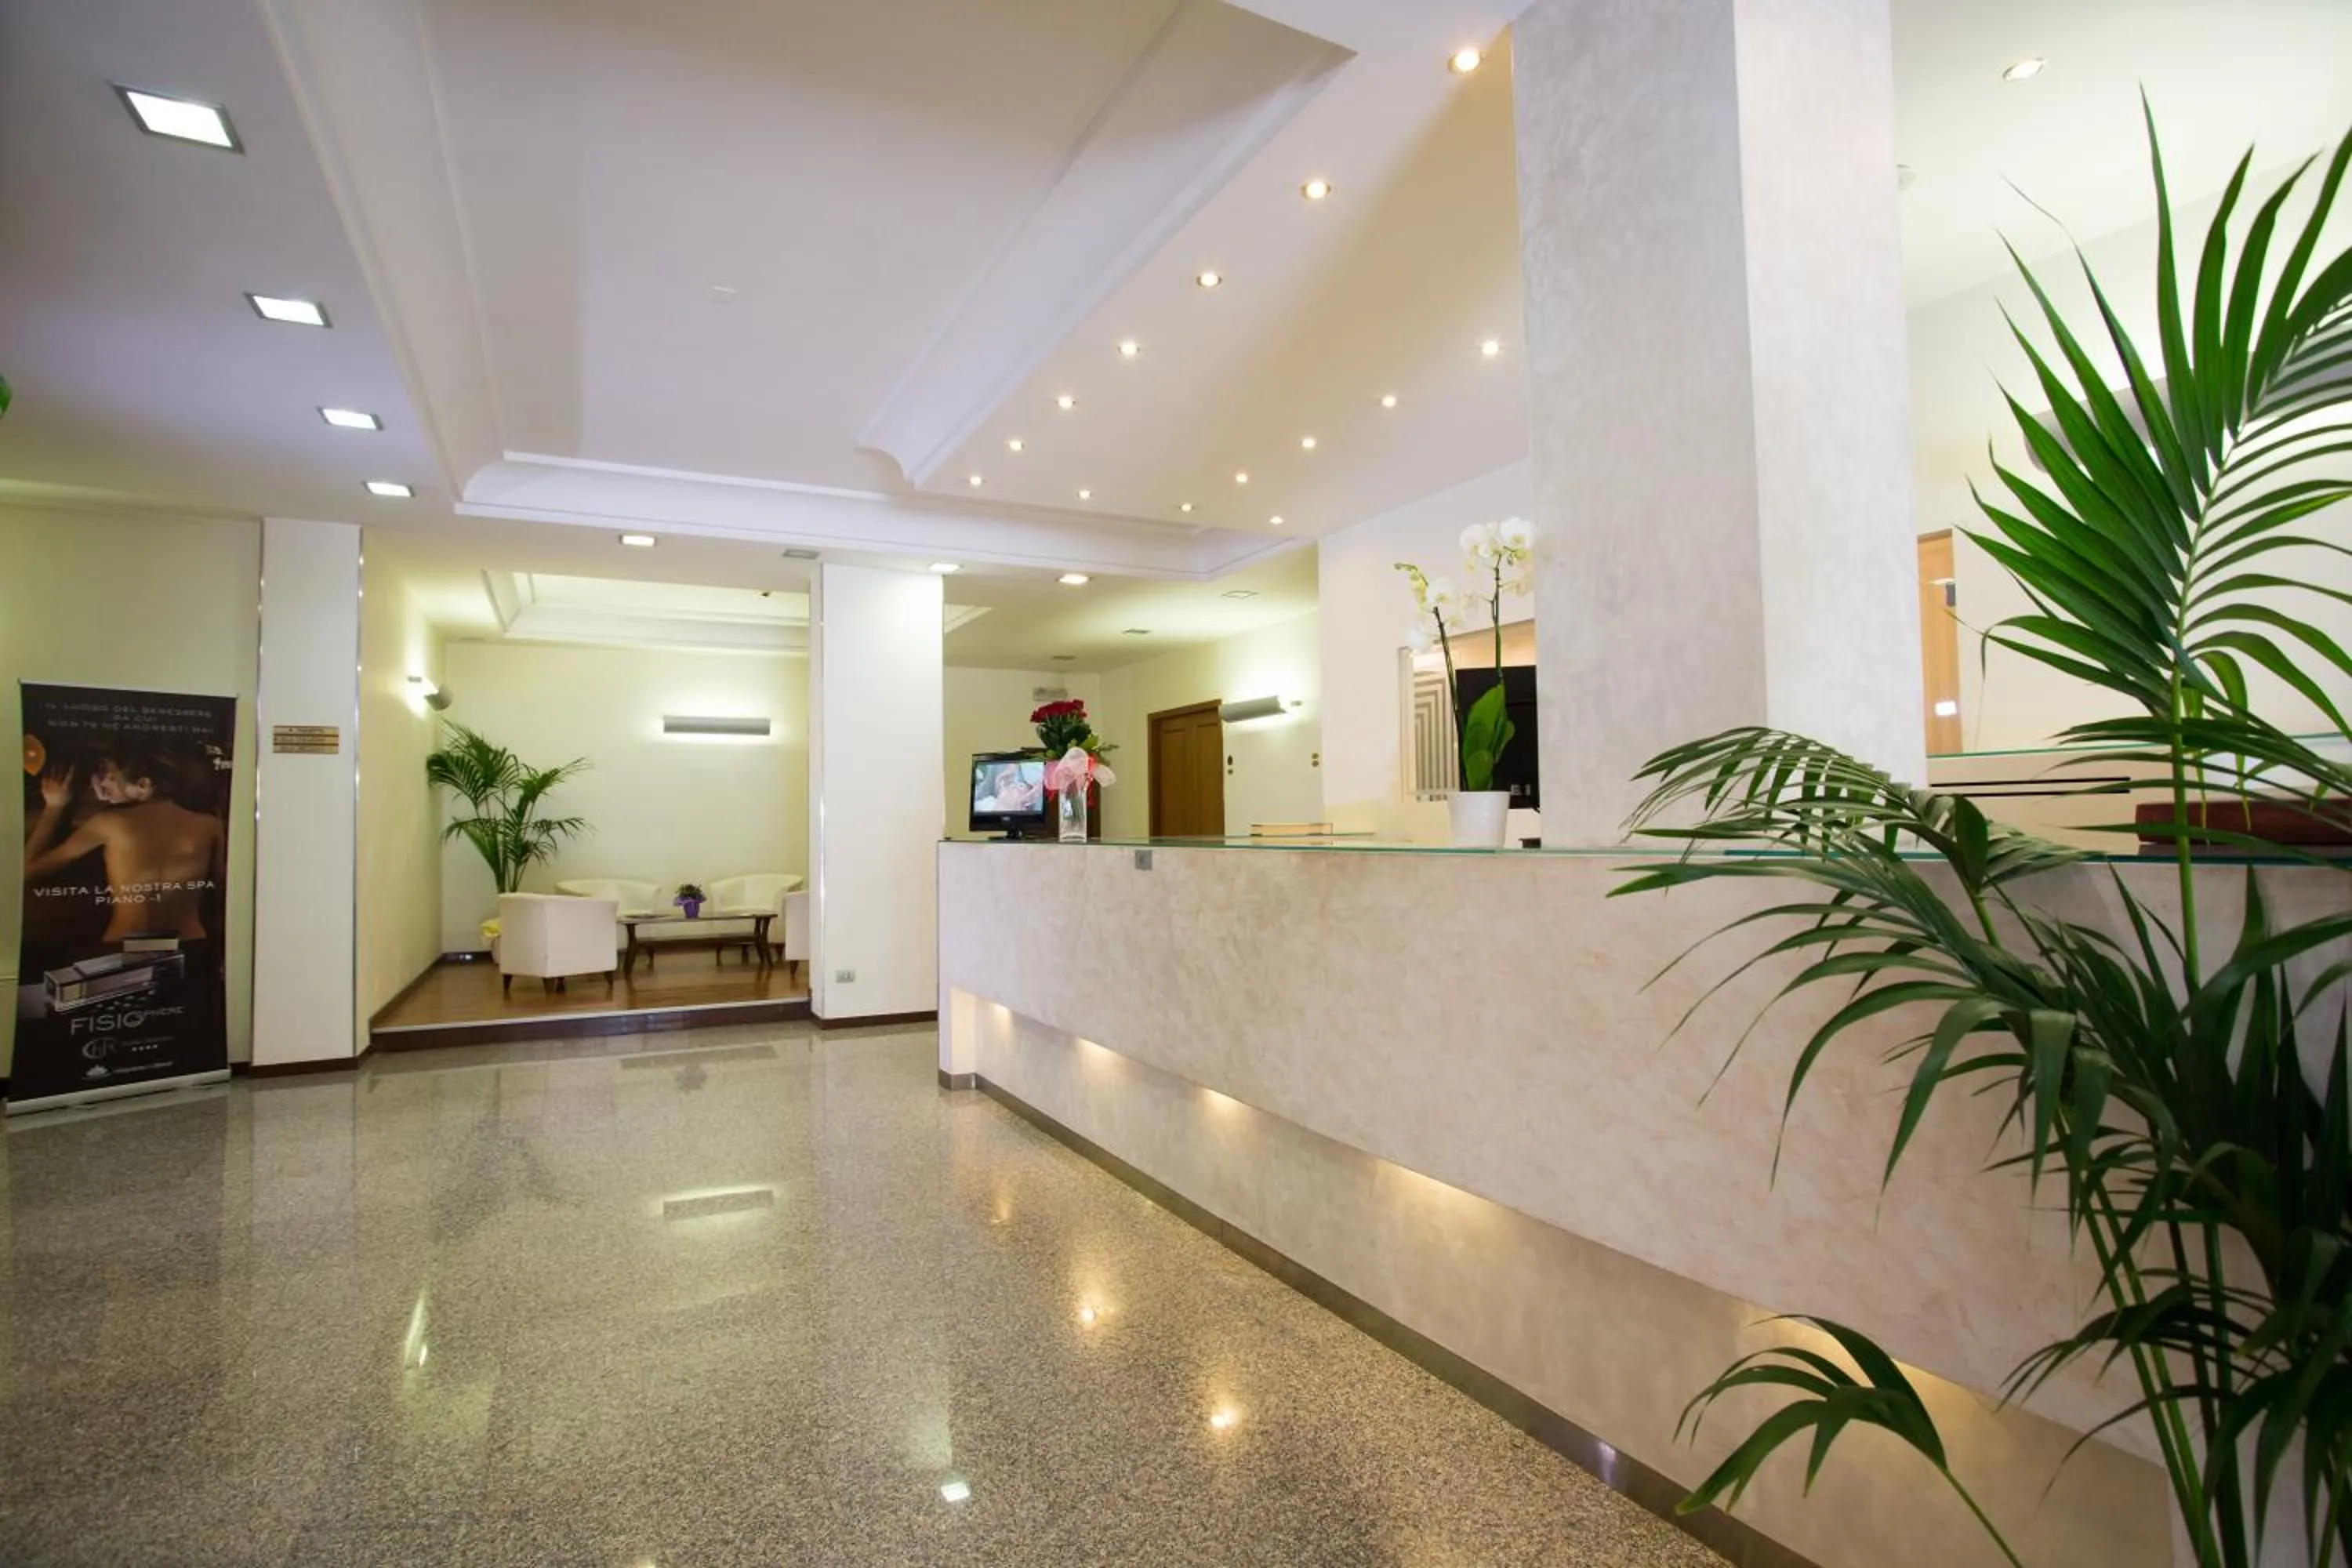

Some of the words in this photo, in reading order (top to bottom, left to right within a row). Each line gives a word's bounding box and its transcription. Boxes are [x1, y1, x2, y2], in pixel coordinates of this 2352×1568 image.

[33, 886, 89, 896] VISITA
[94, 885, 113, 895] LA
[120, 882, 183, 893] NOSTRA
[187, 880, 215, 891] SPA
[95, 895, 145, 905] PIANO
